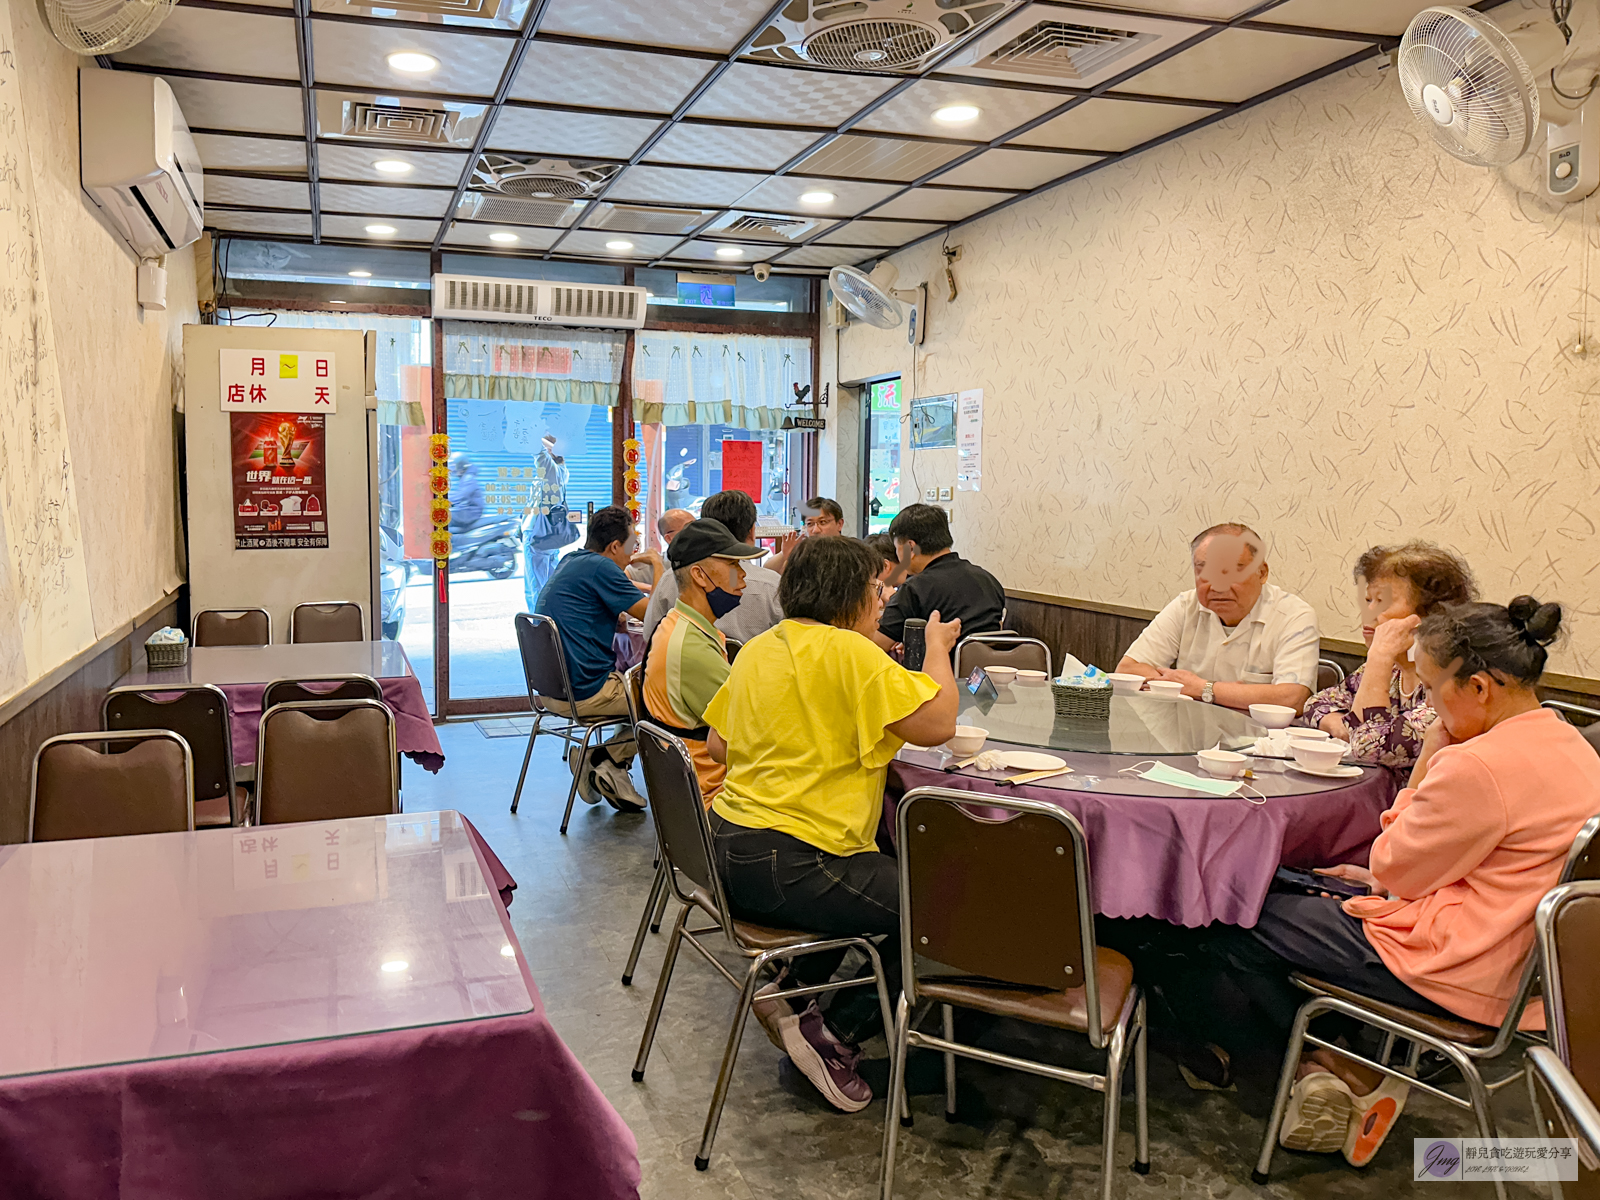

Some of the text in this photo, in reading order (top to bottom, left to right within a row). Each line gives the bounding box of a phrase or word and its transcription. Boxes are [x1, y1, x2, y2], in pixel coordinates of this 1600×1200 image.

[250, 357, 265, 376] 月
[315, 359, 329, 377] 日
[227, 383, 330, 405] 店休 天
[796, 418, 825, 428] WELCOME
